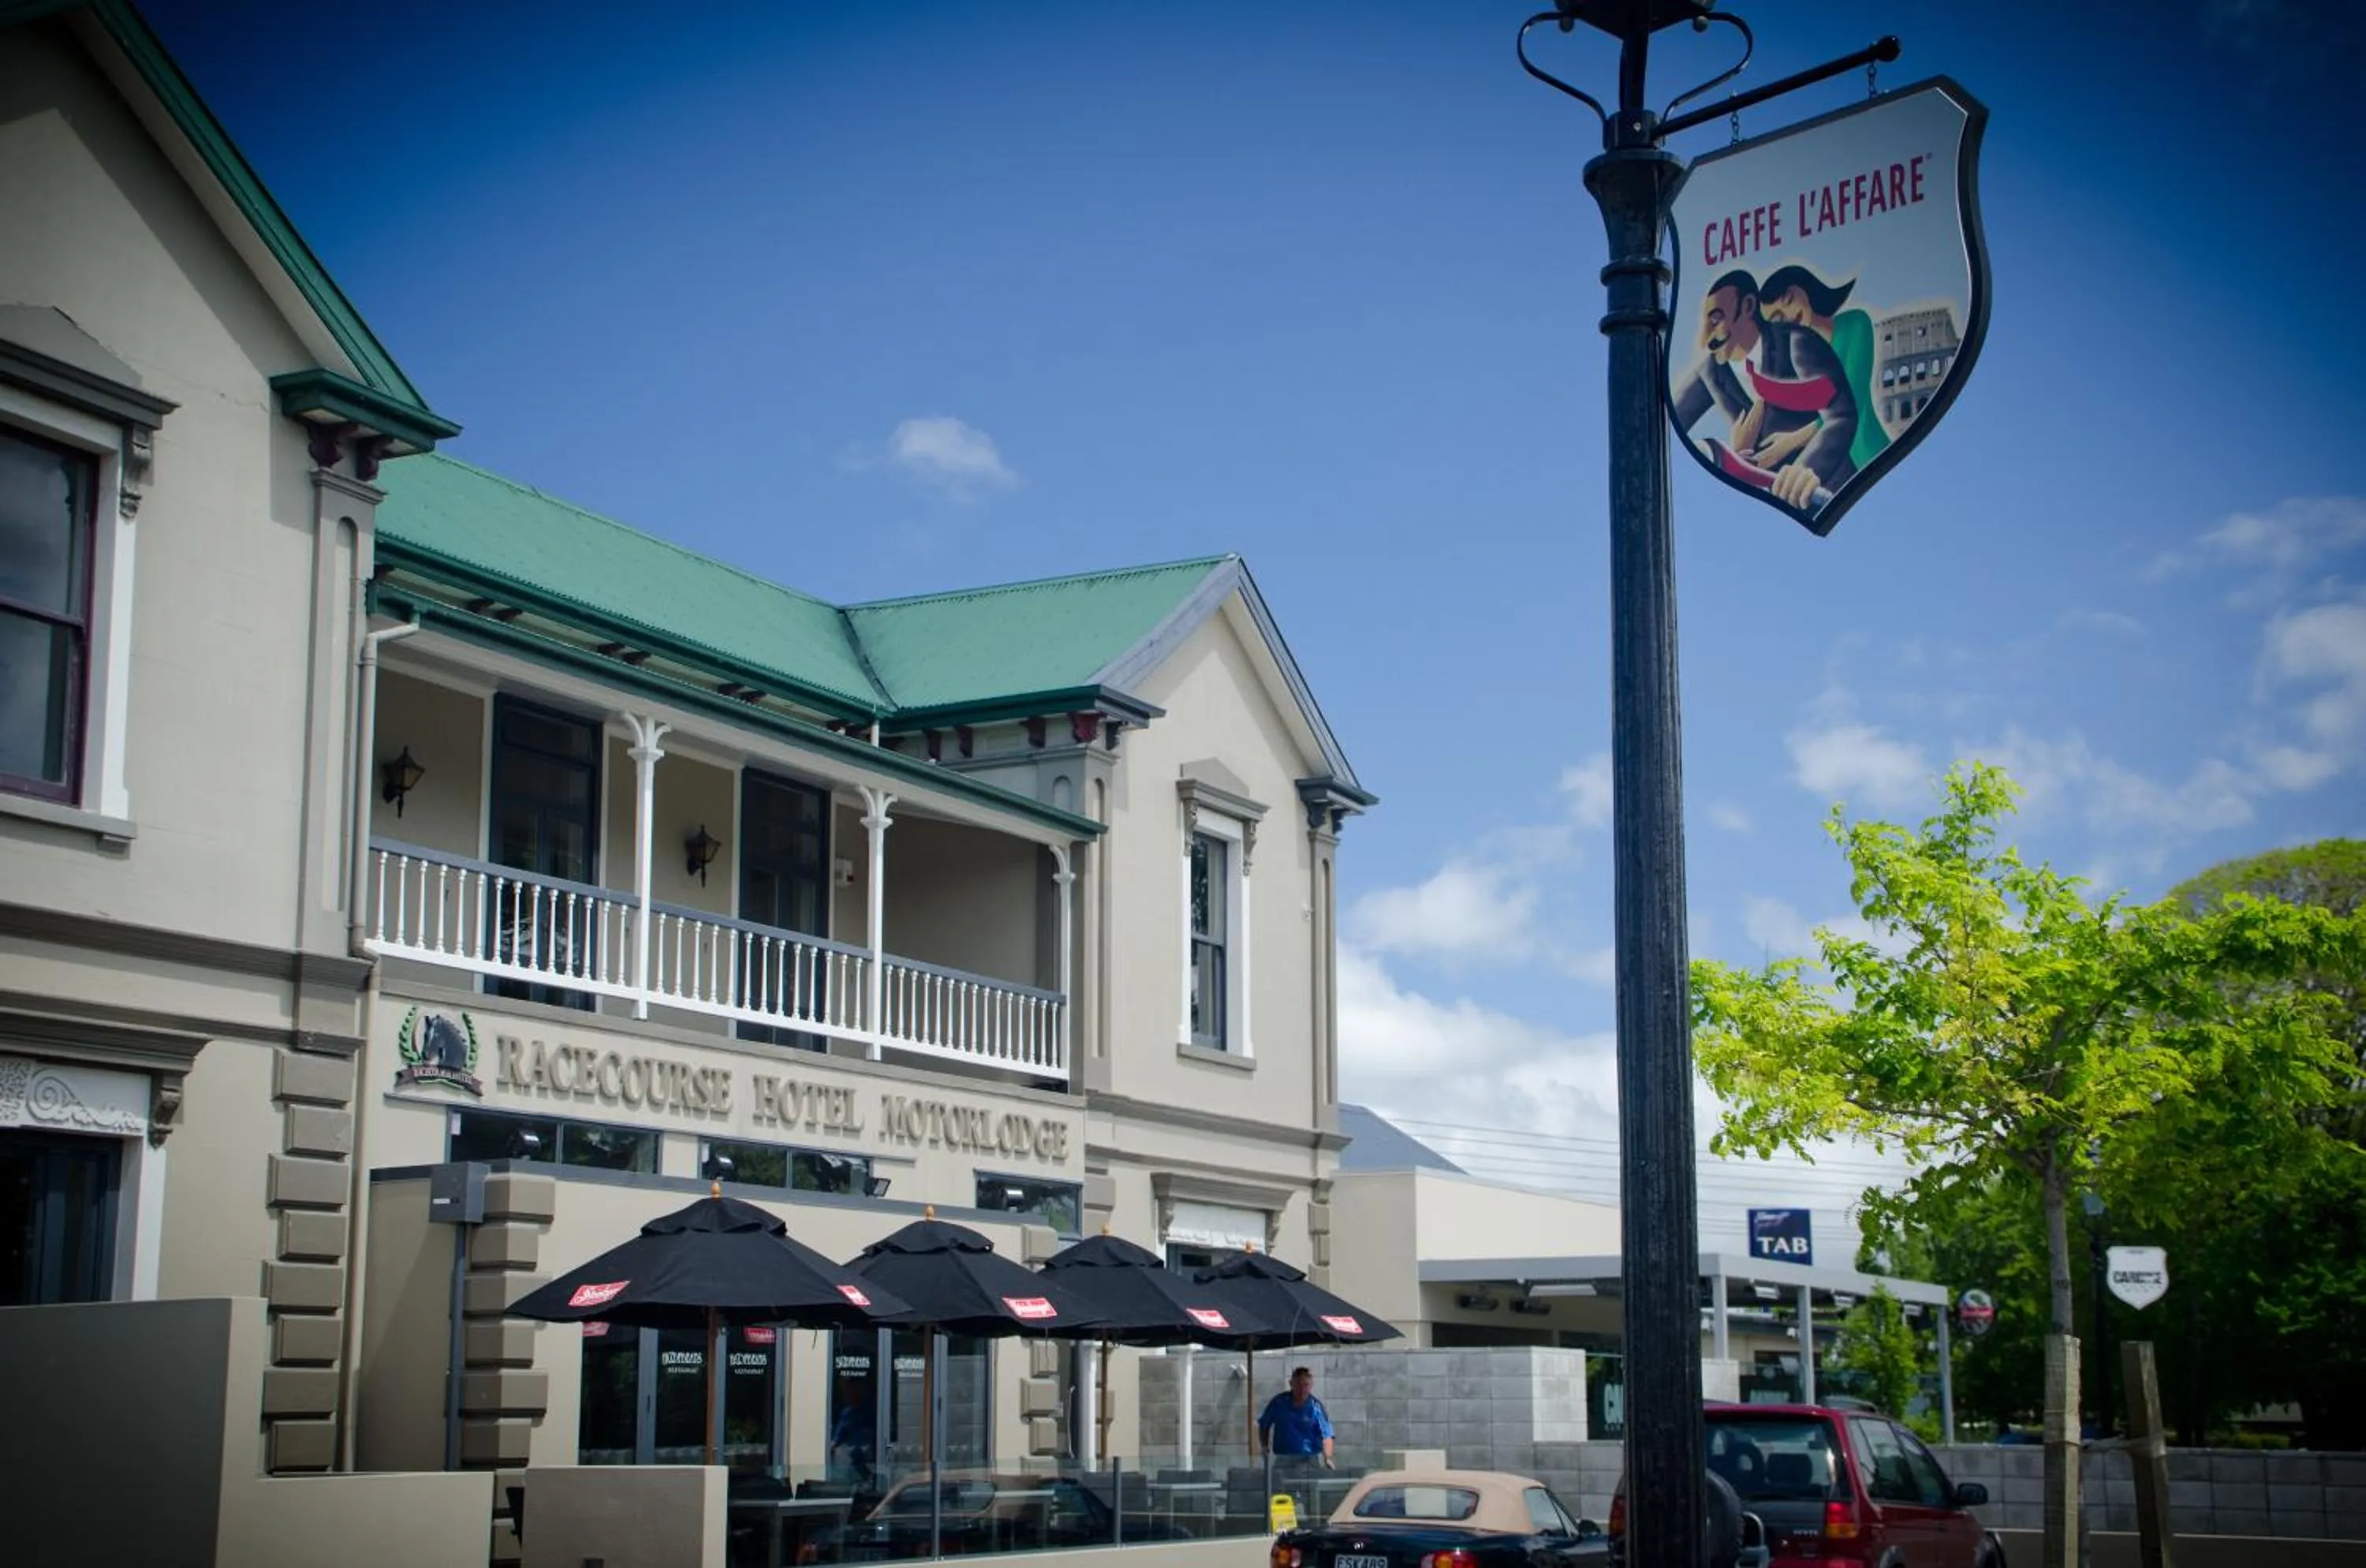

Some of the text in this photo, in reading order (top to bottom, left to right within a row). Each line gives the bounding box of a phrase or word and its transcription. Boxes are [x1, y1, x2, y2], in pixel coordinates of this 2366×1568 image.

[1704, 155, 1925, 266] CAFFE L'AFFARE
[496, 1034, 1069, 1159] RACECOURSE HOTEL MOTORLODGE
[1756, 1237, 1808, 1254] TAB
